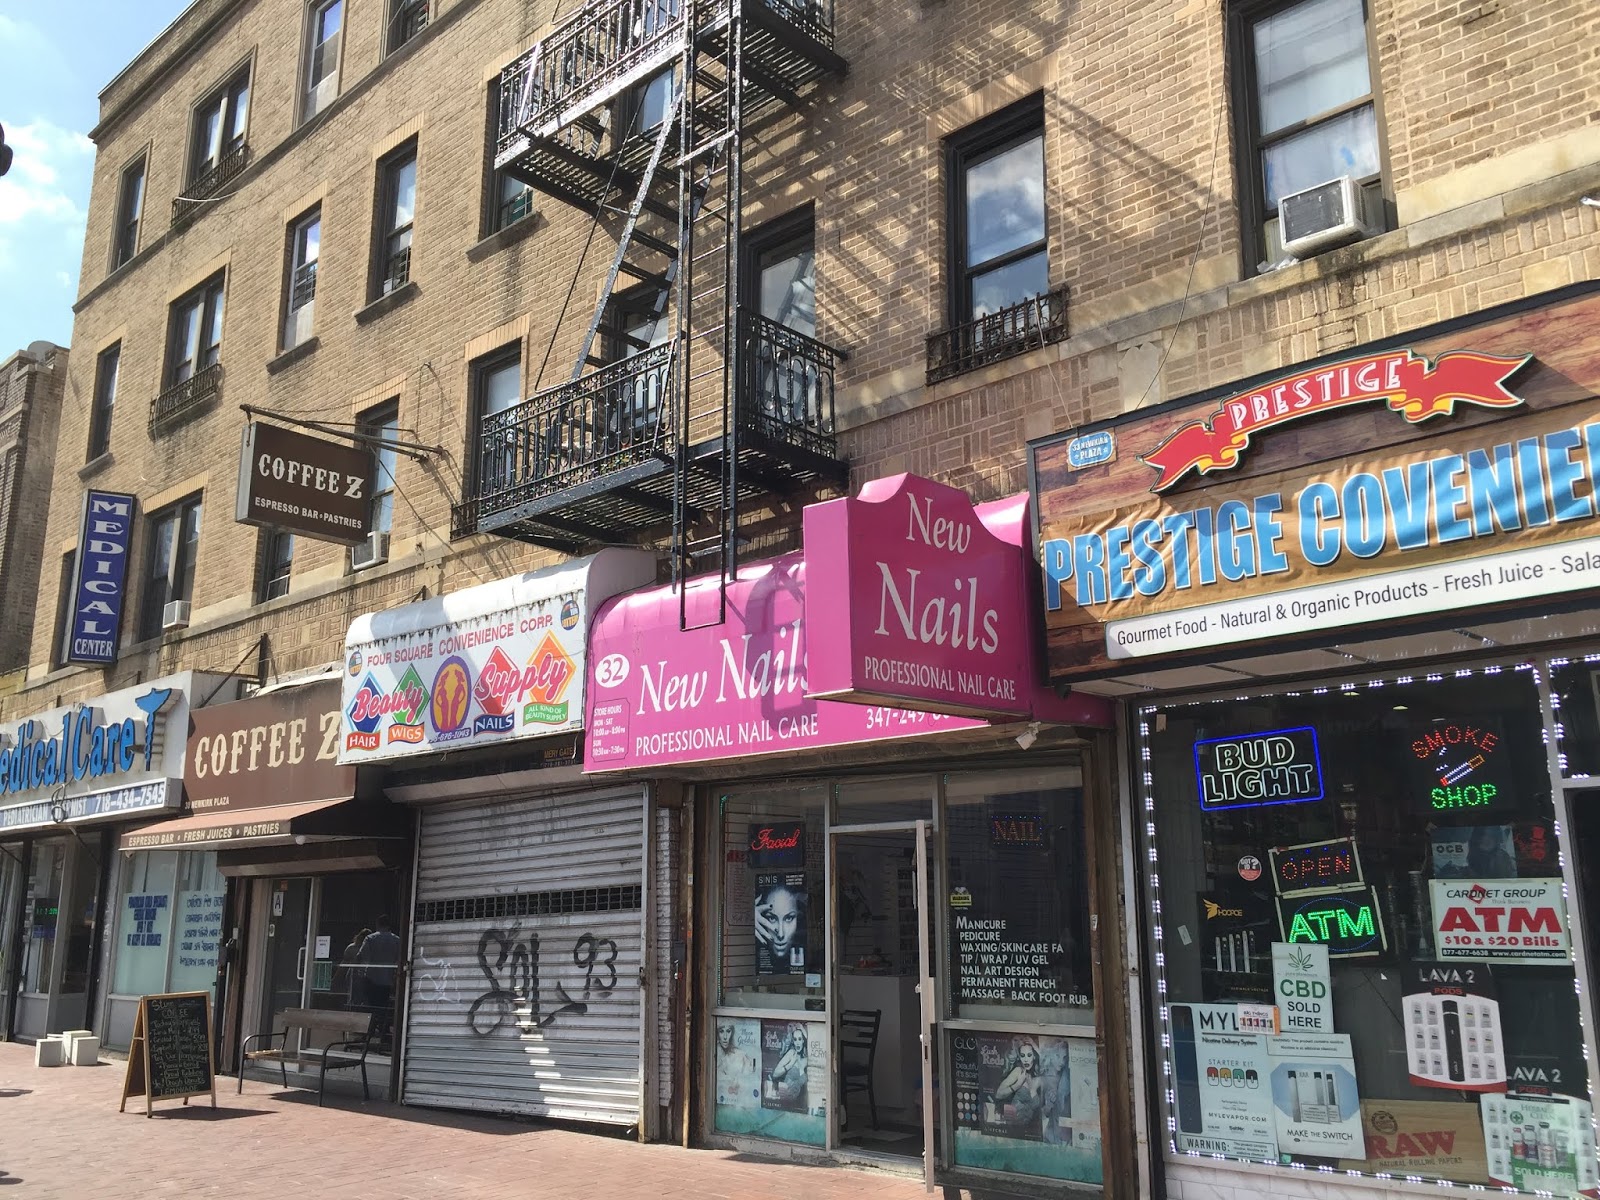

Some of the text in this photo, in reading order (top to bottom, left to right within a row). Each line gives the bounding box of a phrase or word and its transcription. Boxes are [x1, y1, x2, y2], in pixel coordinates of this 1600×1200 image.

[1228, 357, 1403, 431] PRESTIGE
[1080, 447, 1102, 459] PLAZA
[258, 454, 365, 499] COFFEE Z
[255, 497, 362, 529] ESPRESSO BAR PASTRIES
[905, 492, 972, 554] New
[1043, 492, 1290, 611] PRESTIGE
[80, 499, 129, 635] MEDICAL
[874, 560, 999, 654] Nails
[1117, 622, 1172, 646] Gourmet
[1175, 615, 1208, 637] Food
[1220, 604, 1271, 630] Natural
[1275, 602, 1288, 619] &
[1291, 596, 1350, 619] Organic
[1354, 581, 1429, 608] Products
[1444, 568, 1492, 593] Fresh
[1498, 563, 1543, 585] Juice
[74, 638, 113, 657] CENTER
[367, 651, 392, 667] FOUR
[394, 644, 433, 663] SQUARE
[438, 622, 514, 656] CONVENIENCE
[474, 653, 567, 708] Supply
[600, 657, 624, 684] 32
[864, 655, 1016, 700] PROFESSIONAL NAIL CARE
[636, 660, 708, 716] New
[352, 680, 424, 724] Beauty
[475, 712, 513, 731] NAILS
[525, 711, 566, 721] BEAUTY SUPPLY
[349, 734, 377, 748] HAIR
[391, 725, 423, 741] WIGS
[635, 713, 819, 757] PROFESSIONAL NAIL CARE
[1411, 725, 1499, 759] SMOKE
[72, 706, 135, 782] Care
[194, 711, 342, 779] COFFEE Z
[1215, 736, 1295, 772] BUD
[1202, 763, 1313, 803] LIGHT
[3, 783, 165, 826] PEDIATRICIAN 718-434-7545
[214, 796, 230, 806] PLAZA
[1431, 783, 1498, 809] SHOP
[128, 822, 280, 847] ESPRESSO BAR FRESH JUICES PASTRIES
[751, 828, 800, 850] Facial
[993, 820, 1041, 841] NAIL
[1436, 845, 1464, 854] OCB
[1282, 854, 1350, 880] OPEN
[275, 894, 281, 909] A
[1503, 889, 1546, 898] GROUP
[1288, 905, 1376, 944] ATM
[1438, 906, 1563, 933] ATM
[959, 931, 1001, 941] PEDICURE
[1444, 935, 1560, 947] $10 & $20 Bills
[960, 942, 1064, 954] WAXING/SKINCARE FA
[960, 954, 1049, 965] TIP WRAP UV GEL
[960, 965, 1040, 977] NAIL ART DESIGN
[1418, 968, 1475, 984] LAVA 2
[961, 977, 1056, 989] PERMANENT FRENCH
[1279, 978, 1327, 999] CBD
[1434, 987, 1463, 995] PODS
[961, 988, 1089, 1005] MASSAGE BACK FOOT RUB
[1287, 1001, 1321, 1014] SOLD
[1288, 1016, 1322, 1029] HERE
[1201, 1037, 1258, 1047] Nicotine Delivery System
[955, 1053, 965, 1062] So
[1208, 1058, 1240, 1067] STARTER
[1552, 1068, 1562, 1083] 2
[1186, 1138, 1230, 1152] WARNING:
[1287, 1129, 1309, 1138] MAKE
[1322, 1131, 1354, 1141] SWITCH
[1365, 1130, 1457, 1160] RAW
[1438, 1157, 1462, 1165] PAPERS
